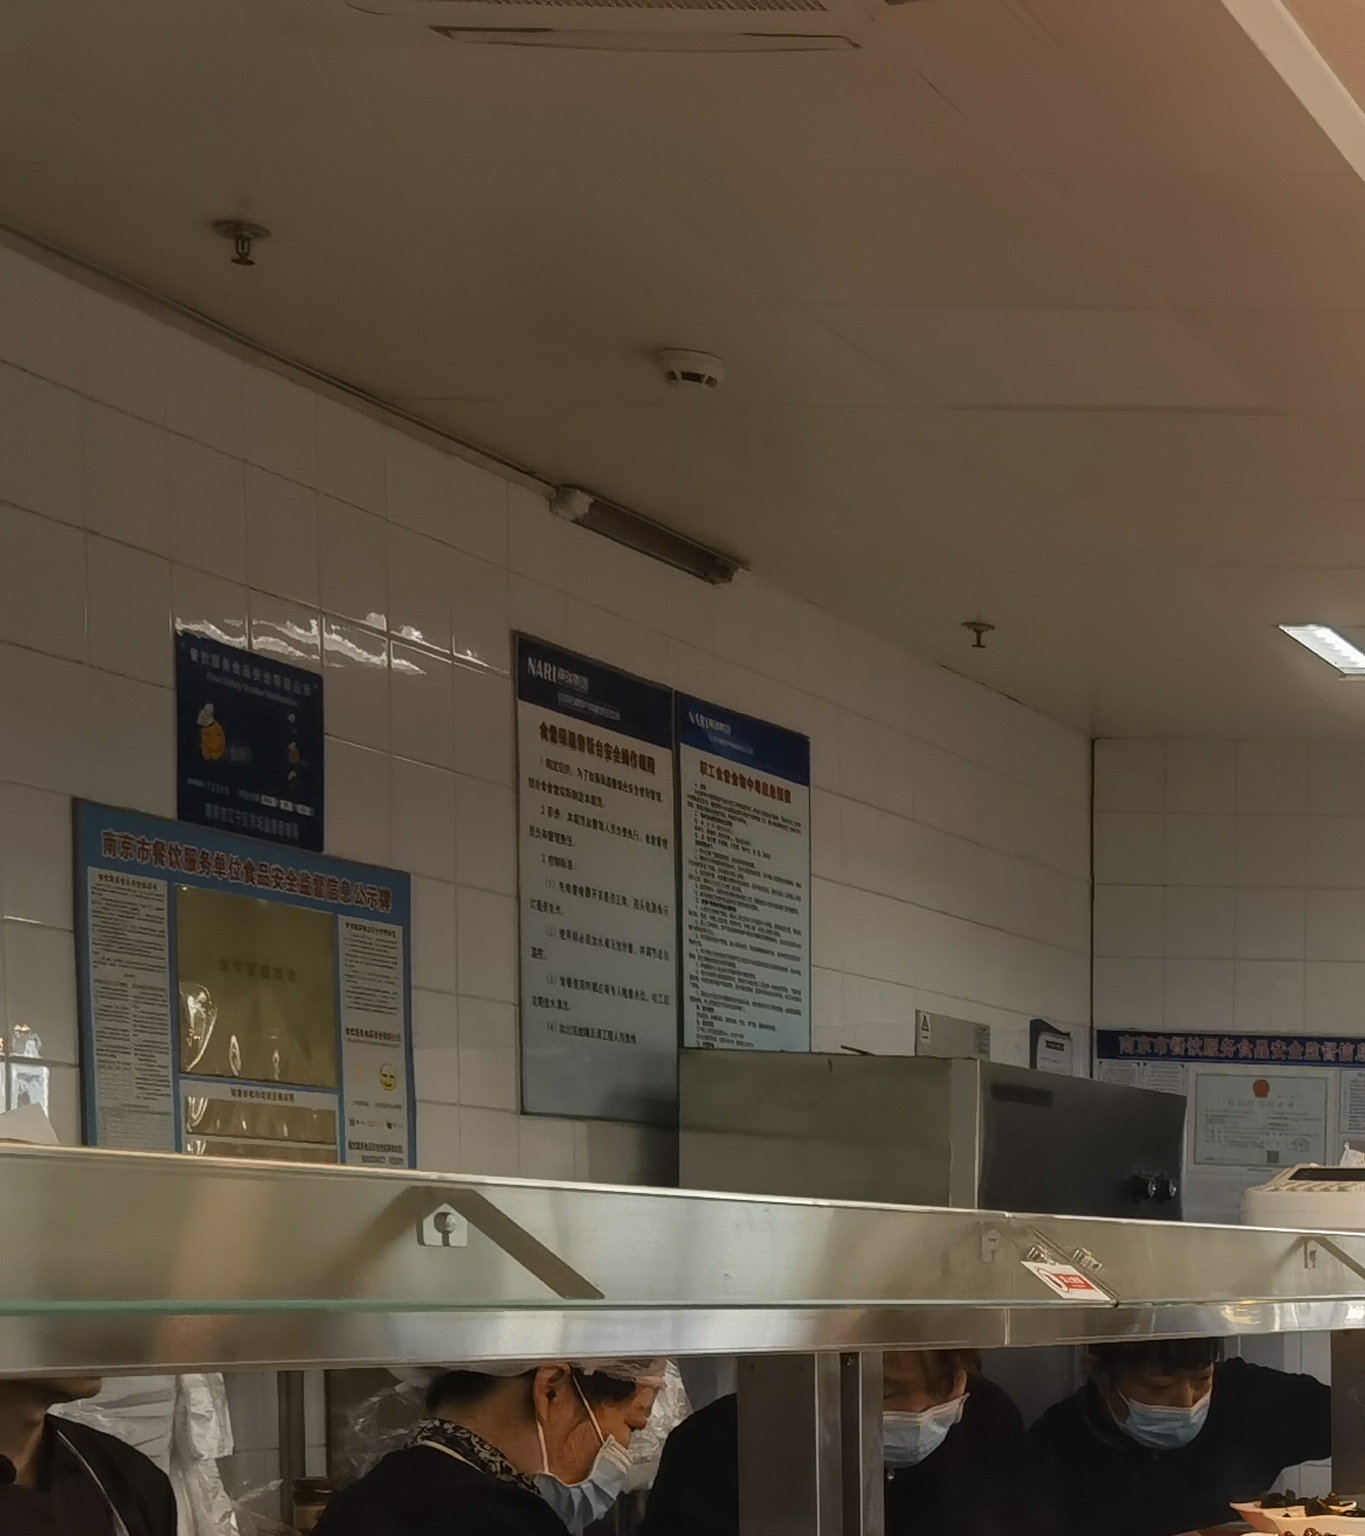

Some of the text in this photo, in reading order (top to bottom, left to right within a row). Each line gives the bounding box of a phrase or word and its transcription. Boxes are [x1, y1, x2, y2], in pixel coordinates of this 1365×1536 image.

[527, 656, 557, 684] NARI
[101, 828, 393, 914] 南京市餐饮服务单位食品安全监督信息公示牌
